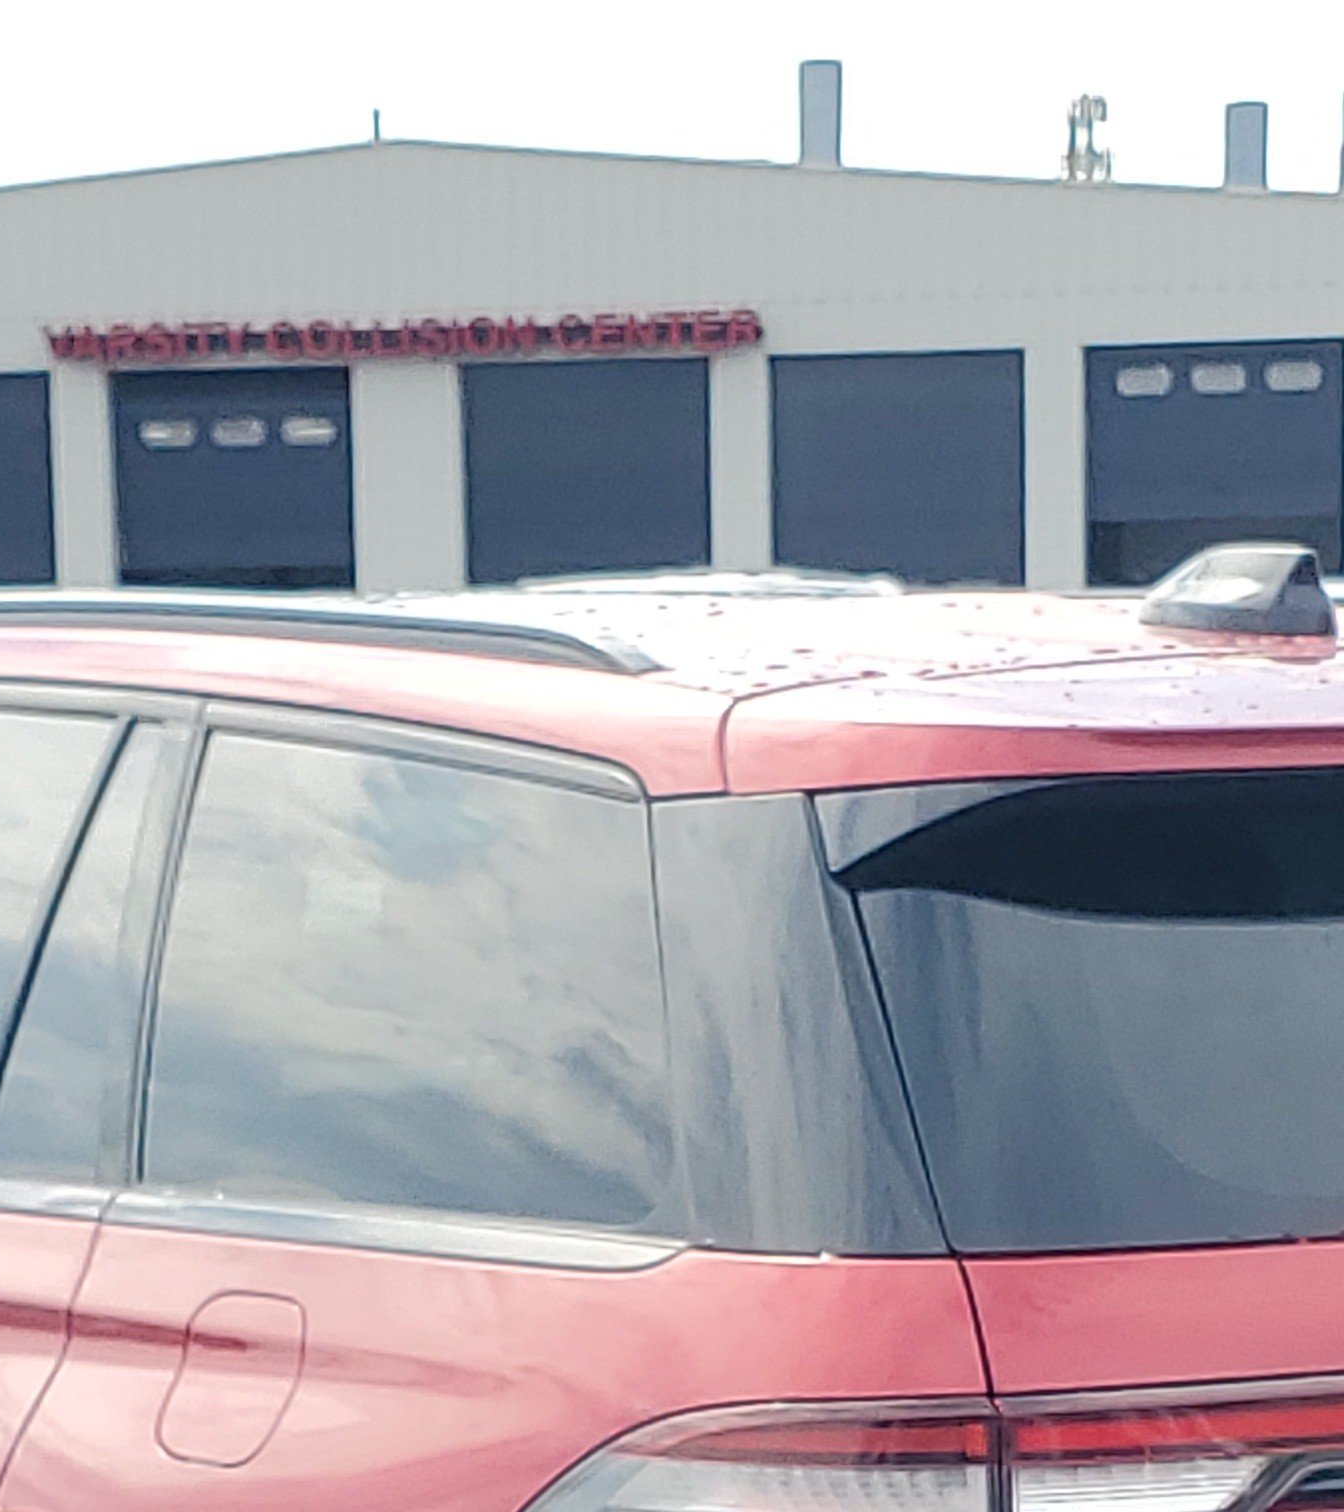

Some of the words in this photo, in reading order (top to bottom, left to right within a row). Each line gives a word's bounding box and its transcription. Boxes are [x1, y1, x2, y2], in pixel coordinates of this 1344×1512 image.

[43, 321, 251, 363] VARSITY
[261, 315, 538, 360] COLLISION
[556, 309, 759, 353] CENTER
